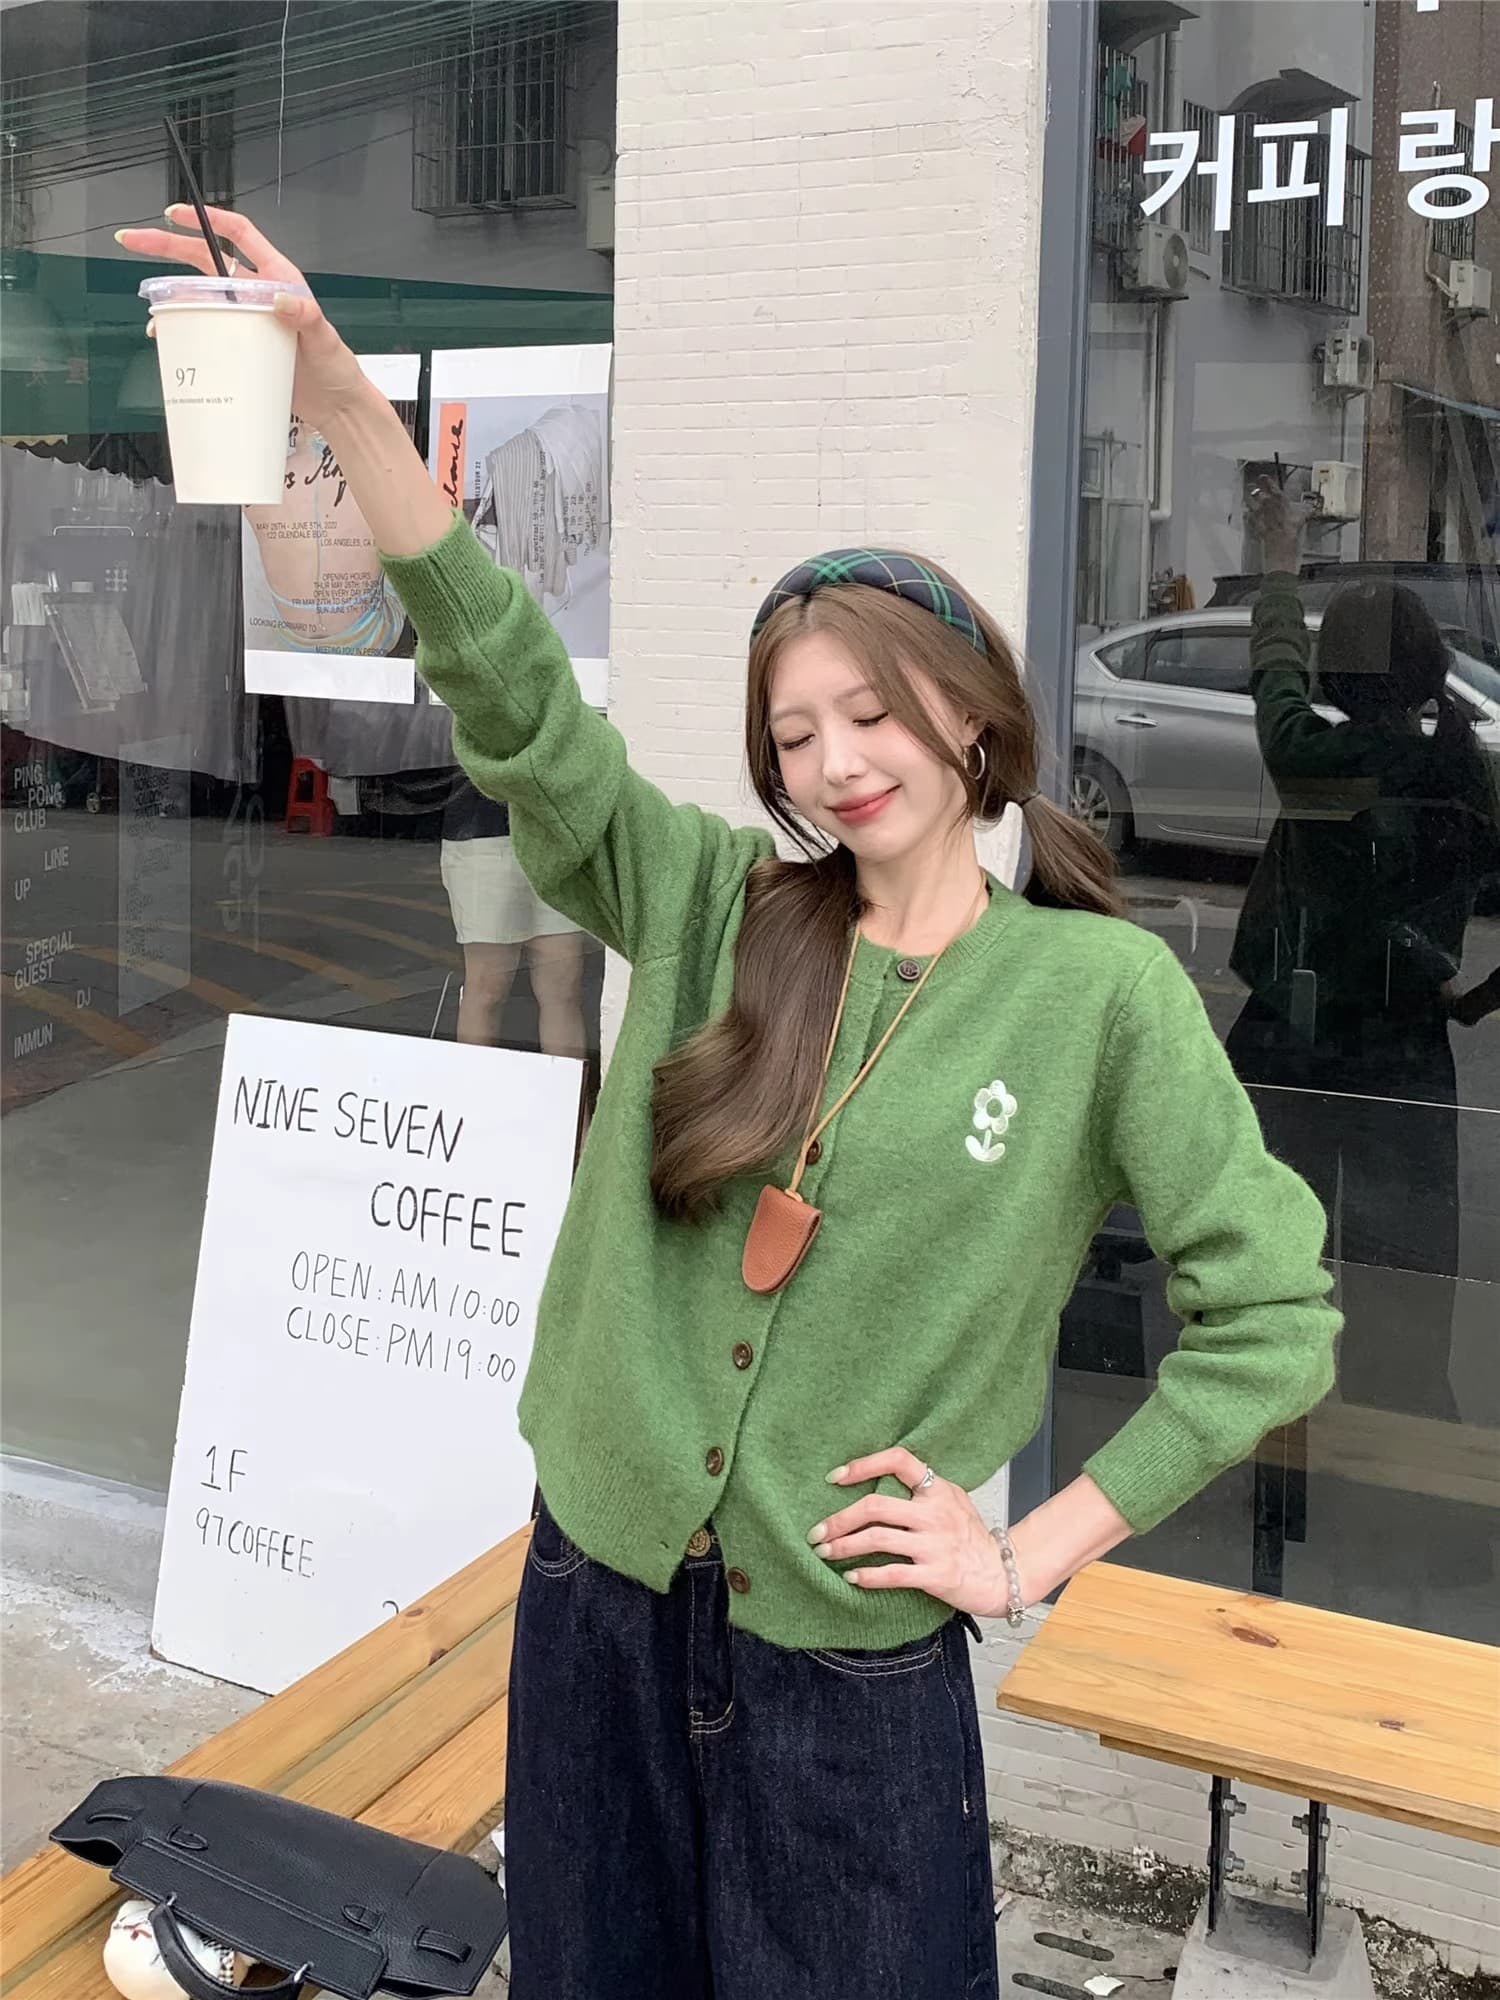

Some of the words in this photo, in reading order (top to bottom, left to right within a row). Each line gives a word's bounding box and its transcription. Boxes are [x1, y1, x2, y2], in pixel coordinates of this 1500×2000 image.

[175, 367, 196, 387] 97
[278, 530, 311, 539] GLENDALE
[291, 521, 309, 530] JUNE
[320, 538, 333, 547] LOS
[363, 538, 371, 547] CA
[322, 573, 349, 581] OPENING
[250, 617, 277, 628] LOOKING
[308, 624, 316, 633] TO
[15, 764, 43, 789] PING
[28, 782, 63, 808] PONG
[14, 807, 46, 833] CLUB
[45, 846, 69, 871] LINE
[15, 878, 31, 900] UP
[26, 930, 74, 965] SPECIAL
[14, 957, 55, 990] GUEST
[77, 988, 92, 1009] DJ
[14, 1024, 53, 1059] IMMUN
[234, 1076, 319, 1132] NINE
[334, 1091, 464, 1163] SEVEN
[370, 1182, 526, 1257] COFFEE
[449, 1284, 520, 1327] 10:00
[444, 1337, 516, 1382] 19:00
[200, 1445, 248, 1492] 1F
